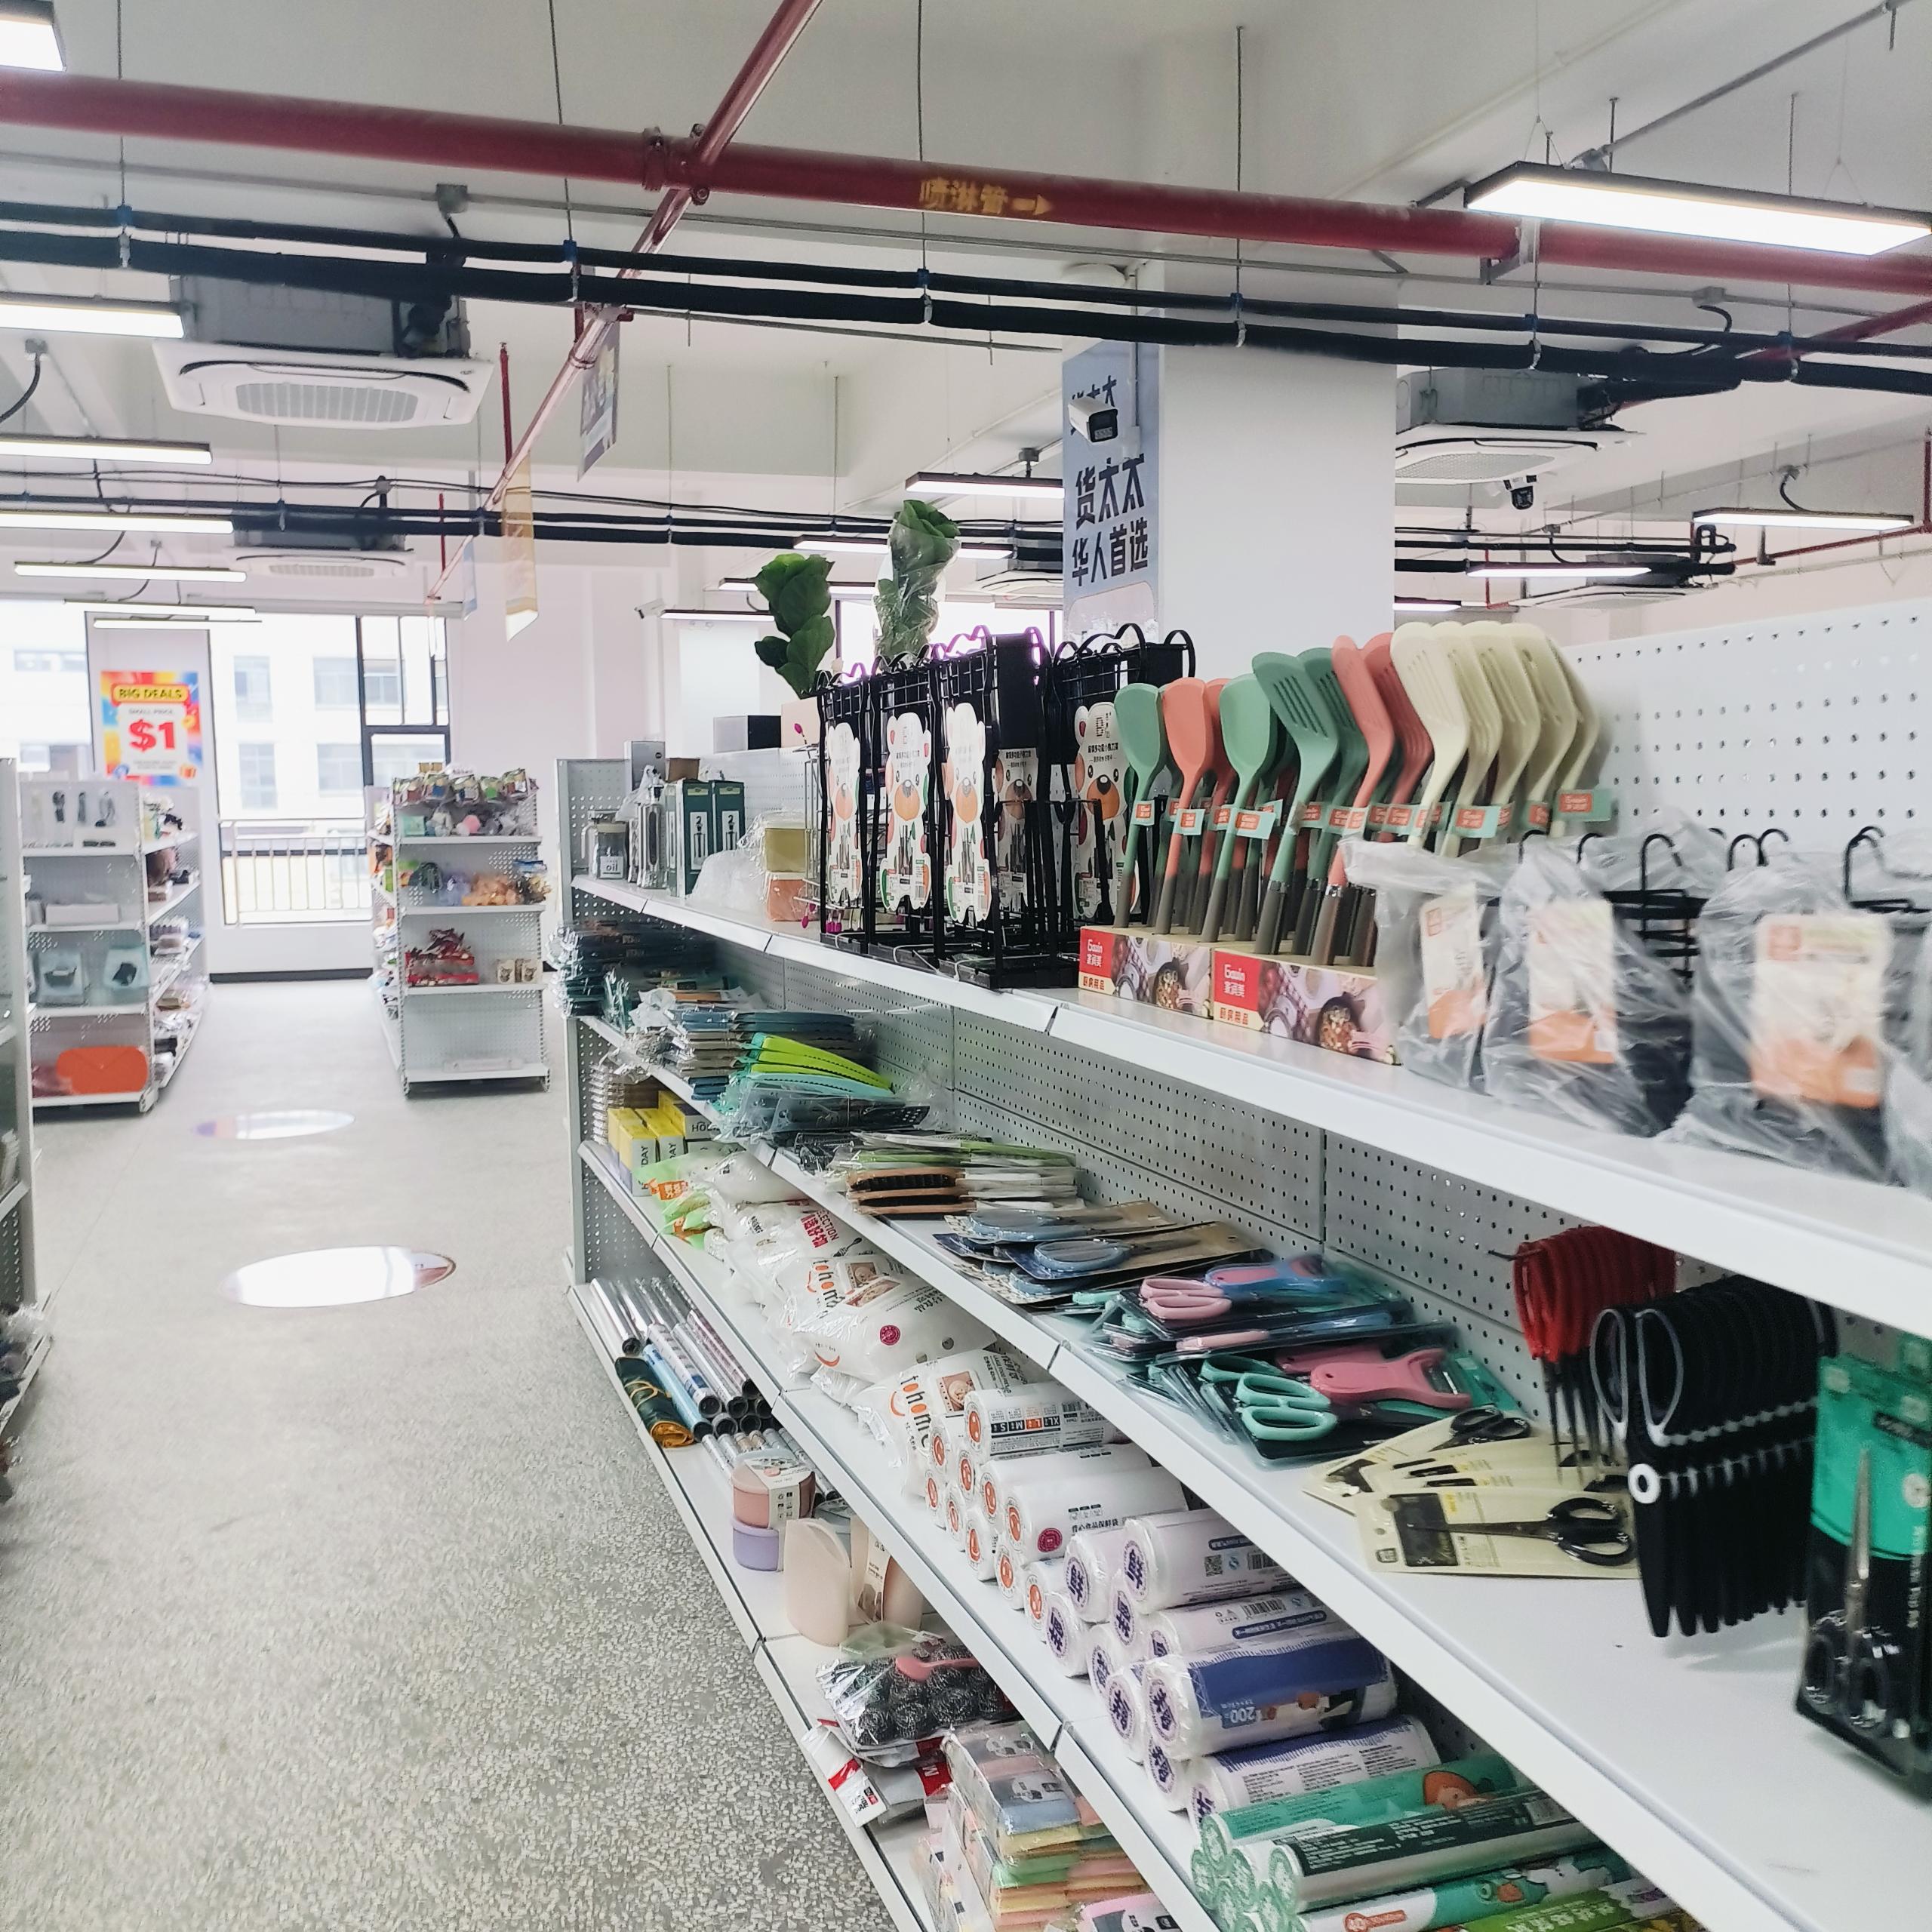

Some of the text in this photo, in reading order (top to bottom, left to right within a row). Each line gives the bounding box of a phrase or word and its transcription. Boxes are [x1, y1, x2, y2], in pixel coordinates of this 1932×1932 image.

[1075, 454, 1146, 531] 货太太
[1072, 517, 1148, 586] 华人首选
[119, 688, 182, 699] BIG DEALS
[129, 719, 175, 752] $1
